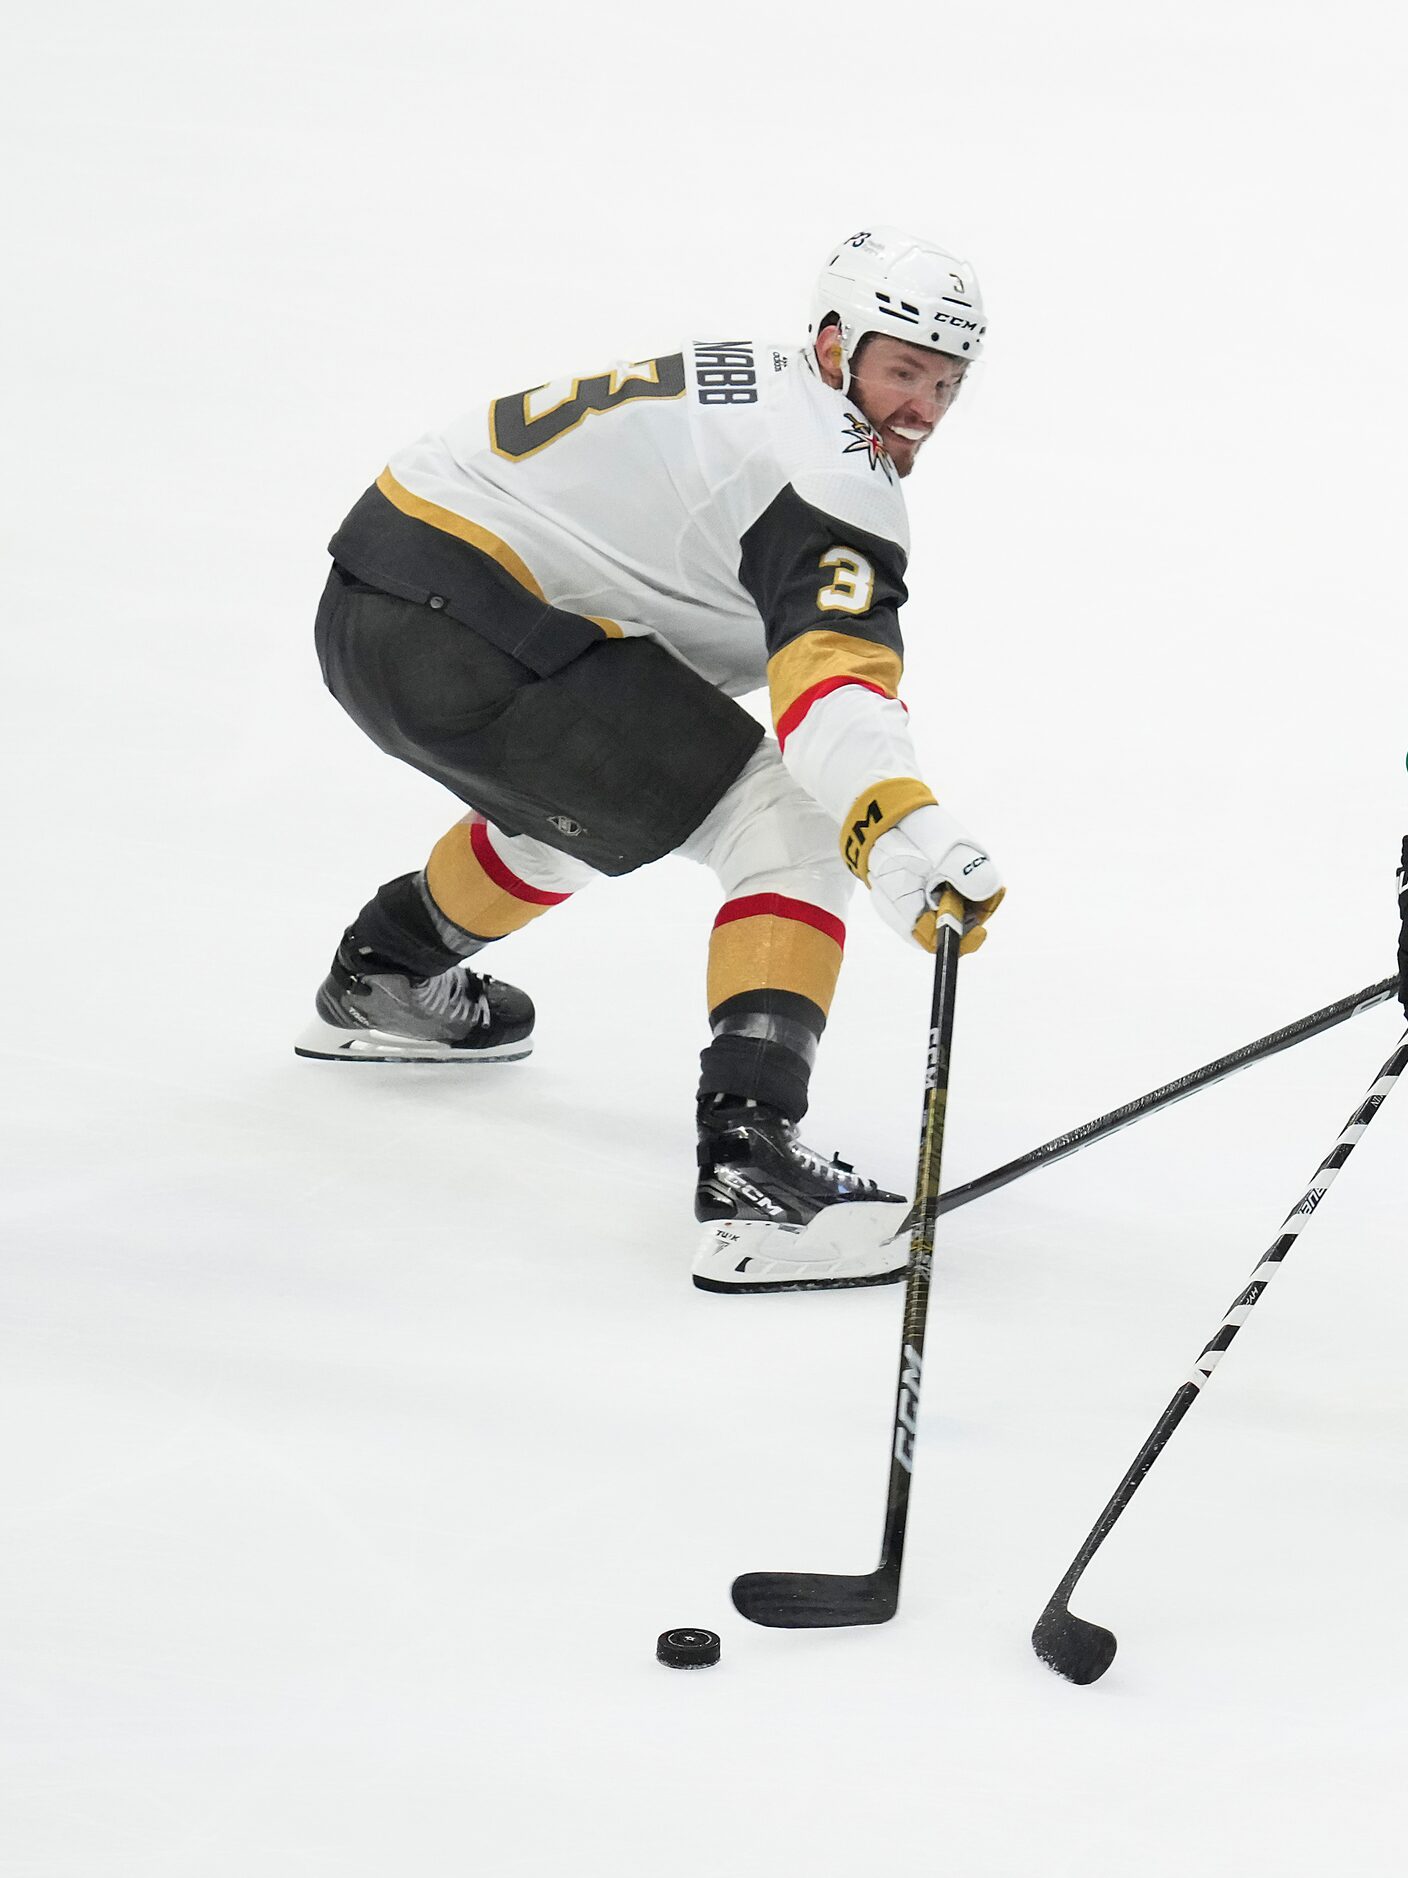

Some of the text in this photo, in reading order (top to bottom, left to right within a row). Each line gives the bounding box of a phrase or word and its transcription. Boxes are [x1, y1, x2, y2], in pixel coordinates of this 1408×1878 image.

[934, 312, 978, 331] CCM
[488, 351, 688, 464] 3
[816, 544, 876, 615] 3
[721, 1167, 784, 1216] CCM
[893, 1342, 923, 1475] CCM
